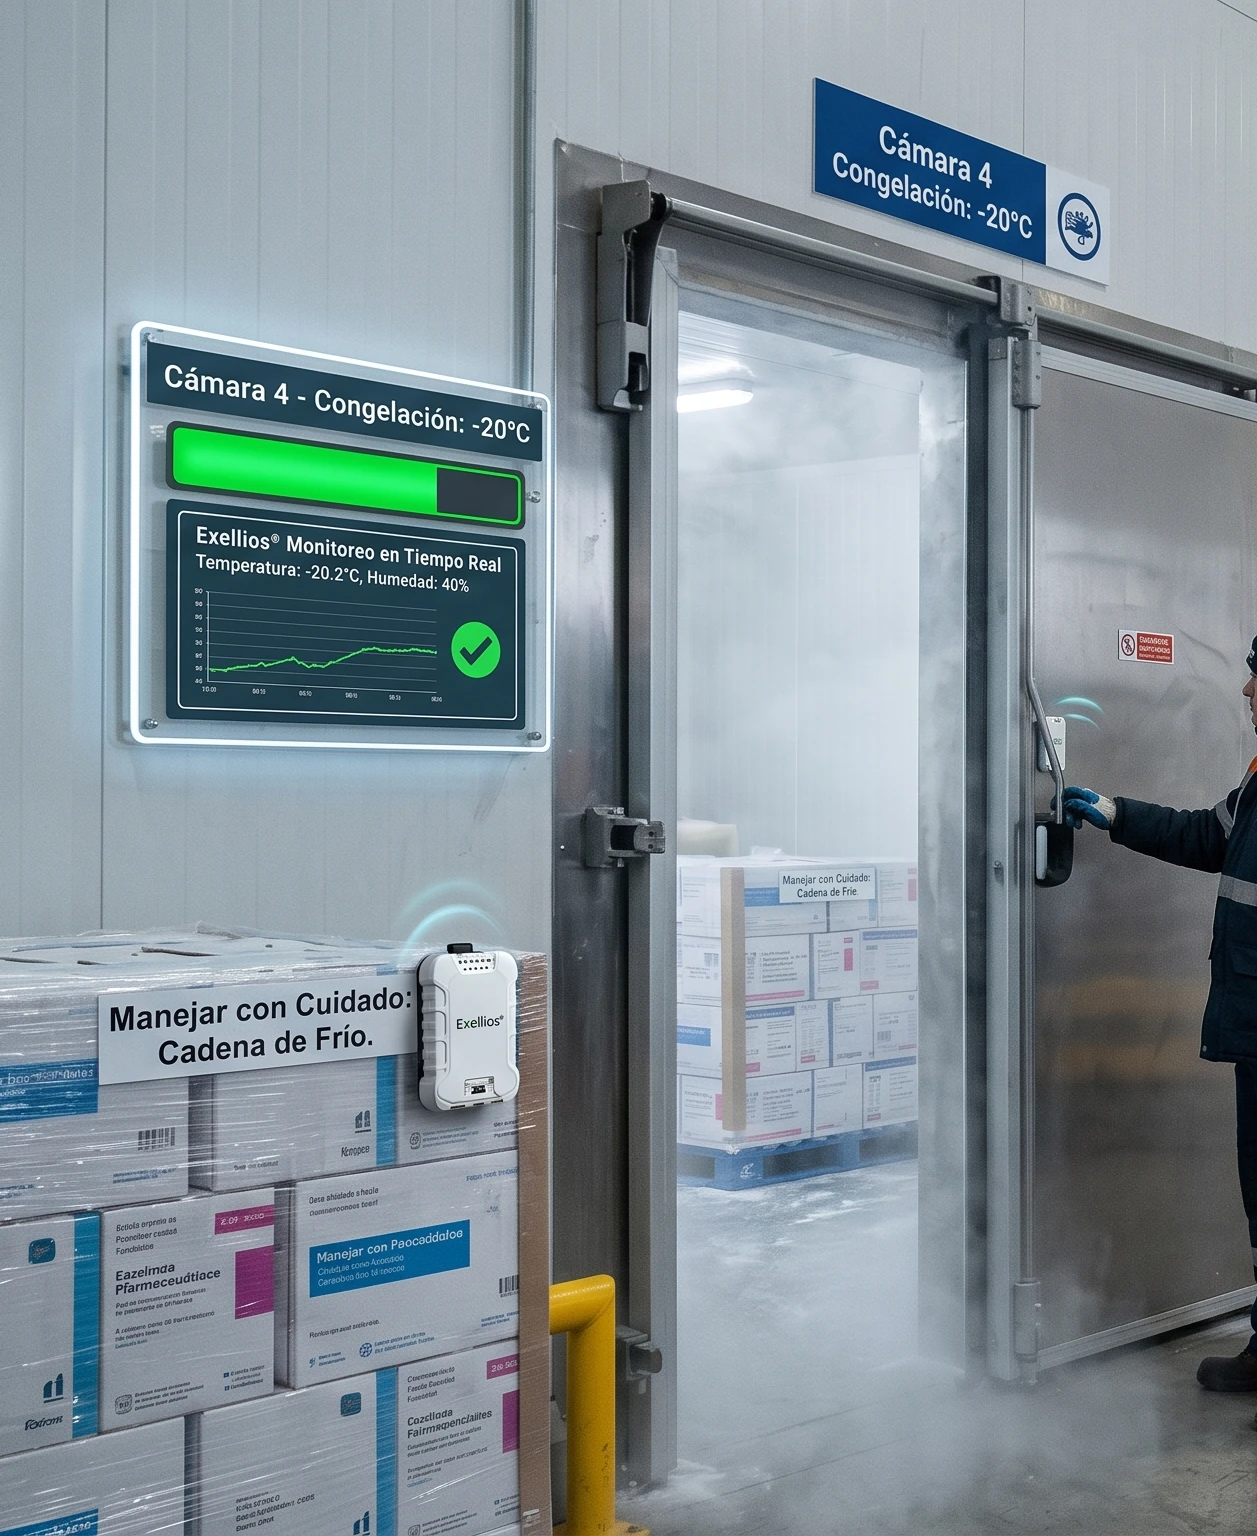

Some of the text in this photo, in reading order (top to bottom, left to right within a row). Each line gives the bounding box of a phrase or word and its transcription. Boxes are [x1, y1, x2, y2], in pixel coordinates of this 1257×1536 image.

[879, 125, 992, 189] Cámara 4
[833, 152, 971, 219] Congelación:
[164, 364, 265, 402] Cámara
[273, 382, 289, 405] 4
[314, 389, 465, 434] Congelación:
[196, 526, 502, 574] Exellios® Monitoreo en Tiempo Real
[196, 553, 470, 593] Temperatura: -20.2°C, Humedad: 40%
[782, 874, 816, 887] Manejar
[818, 876, 834, 884] con
[797, 888, 828, 898] Cadena
[830, 887, 840, 897] de
[109, 986, 413, 1035] Manejar con Cuidado:
[158, 1023, 374, 1065] Cadena de Frío.
[317, 1246, 363, 1264] Manejar
[367, 1243, 388, 1255] con
